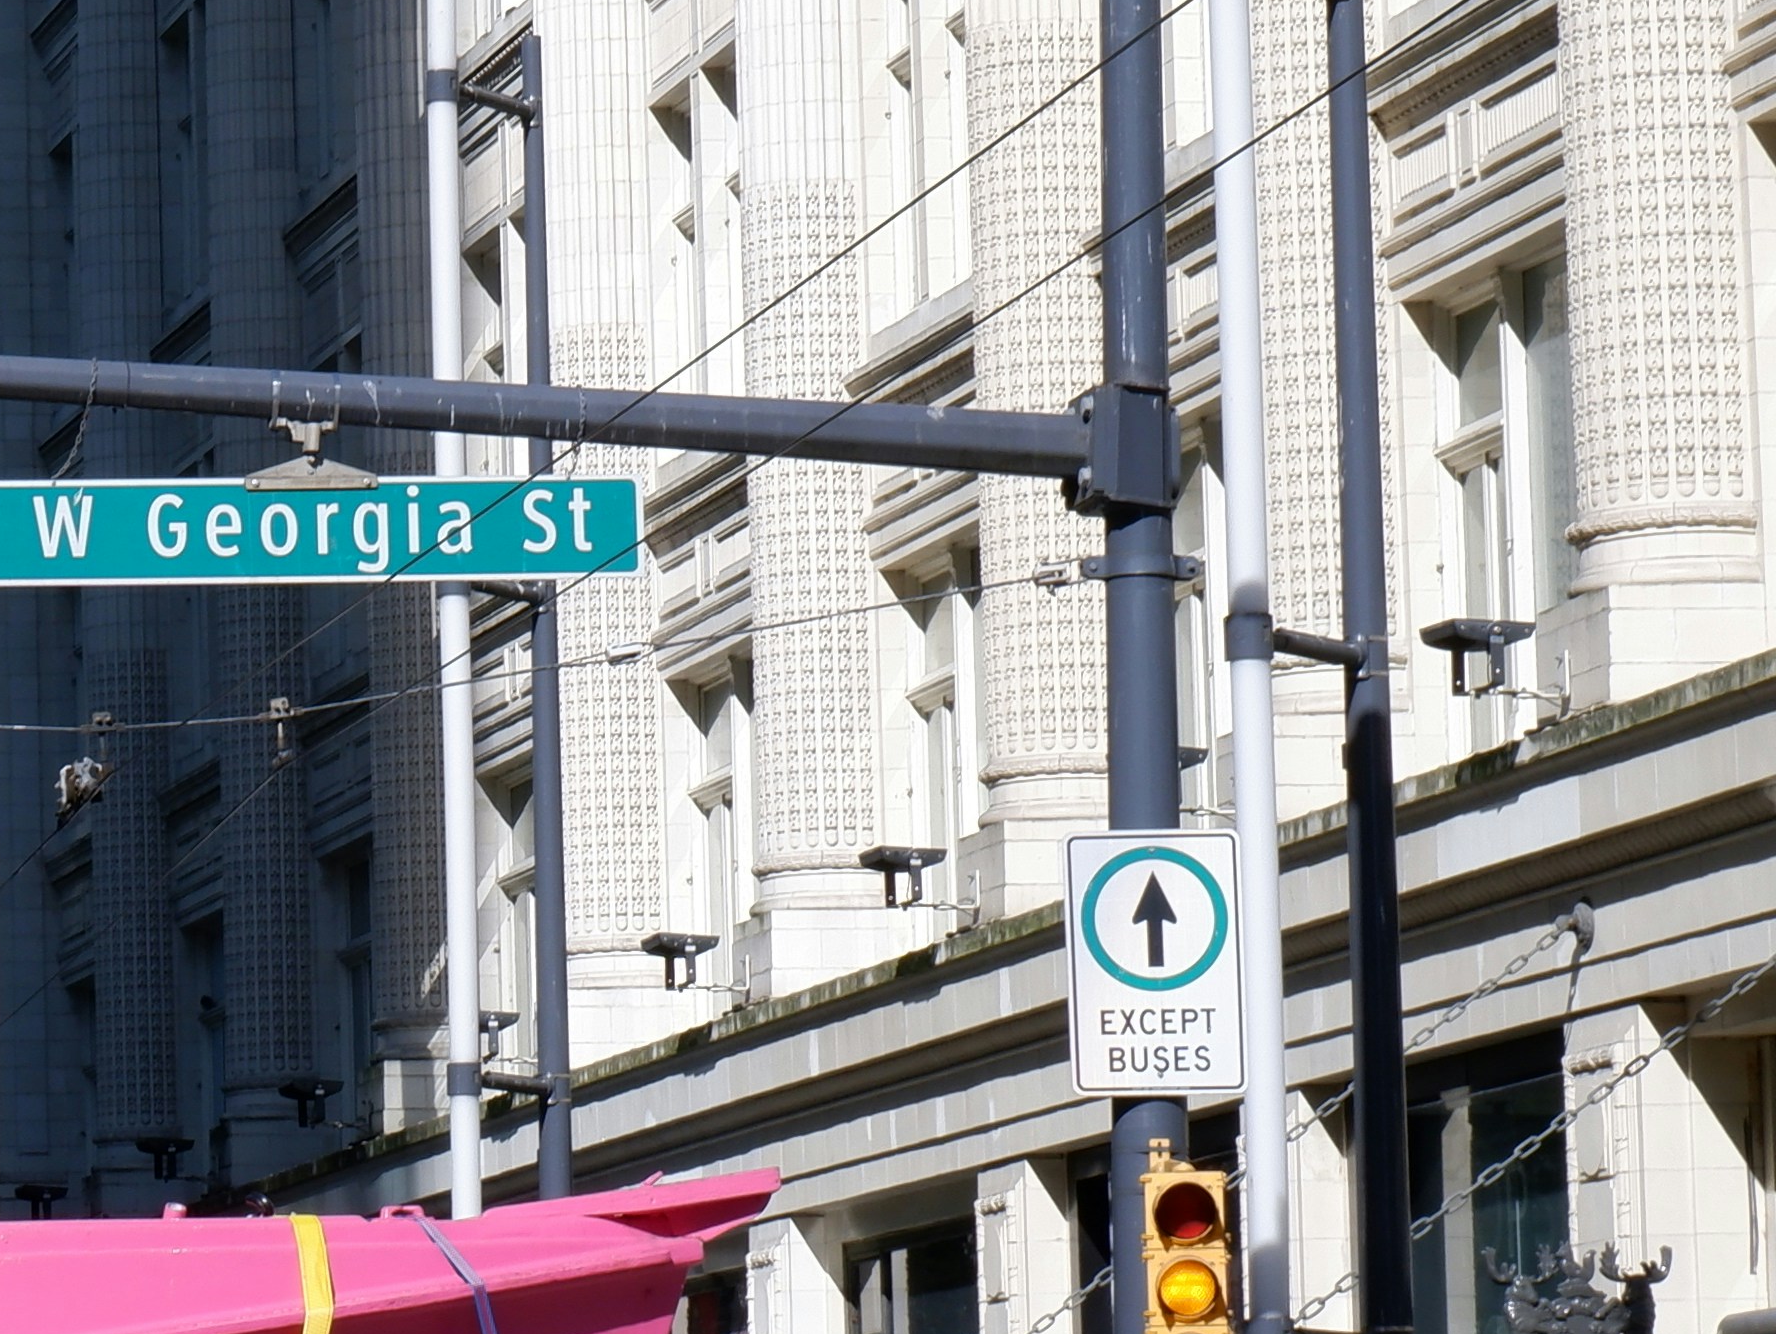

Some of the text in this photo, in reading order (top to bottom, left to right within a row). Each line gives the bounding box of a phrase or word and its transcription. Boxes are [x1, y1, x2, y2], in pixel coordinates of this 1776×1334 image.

[33, 485, 593, 574] W Georgia St
[1100, 1008, 1216, 1035] EXCEPT
[1109, 1045, 1211, 1073] BUSES
